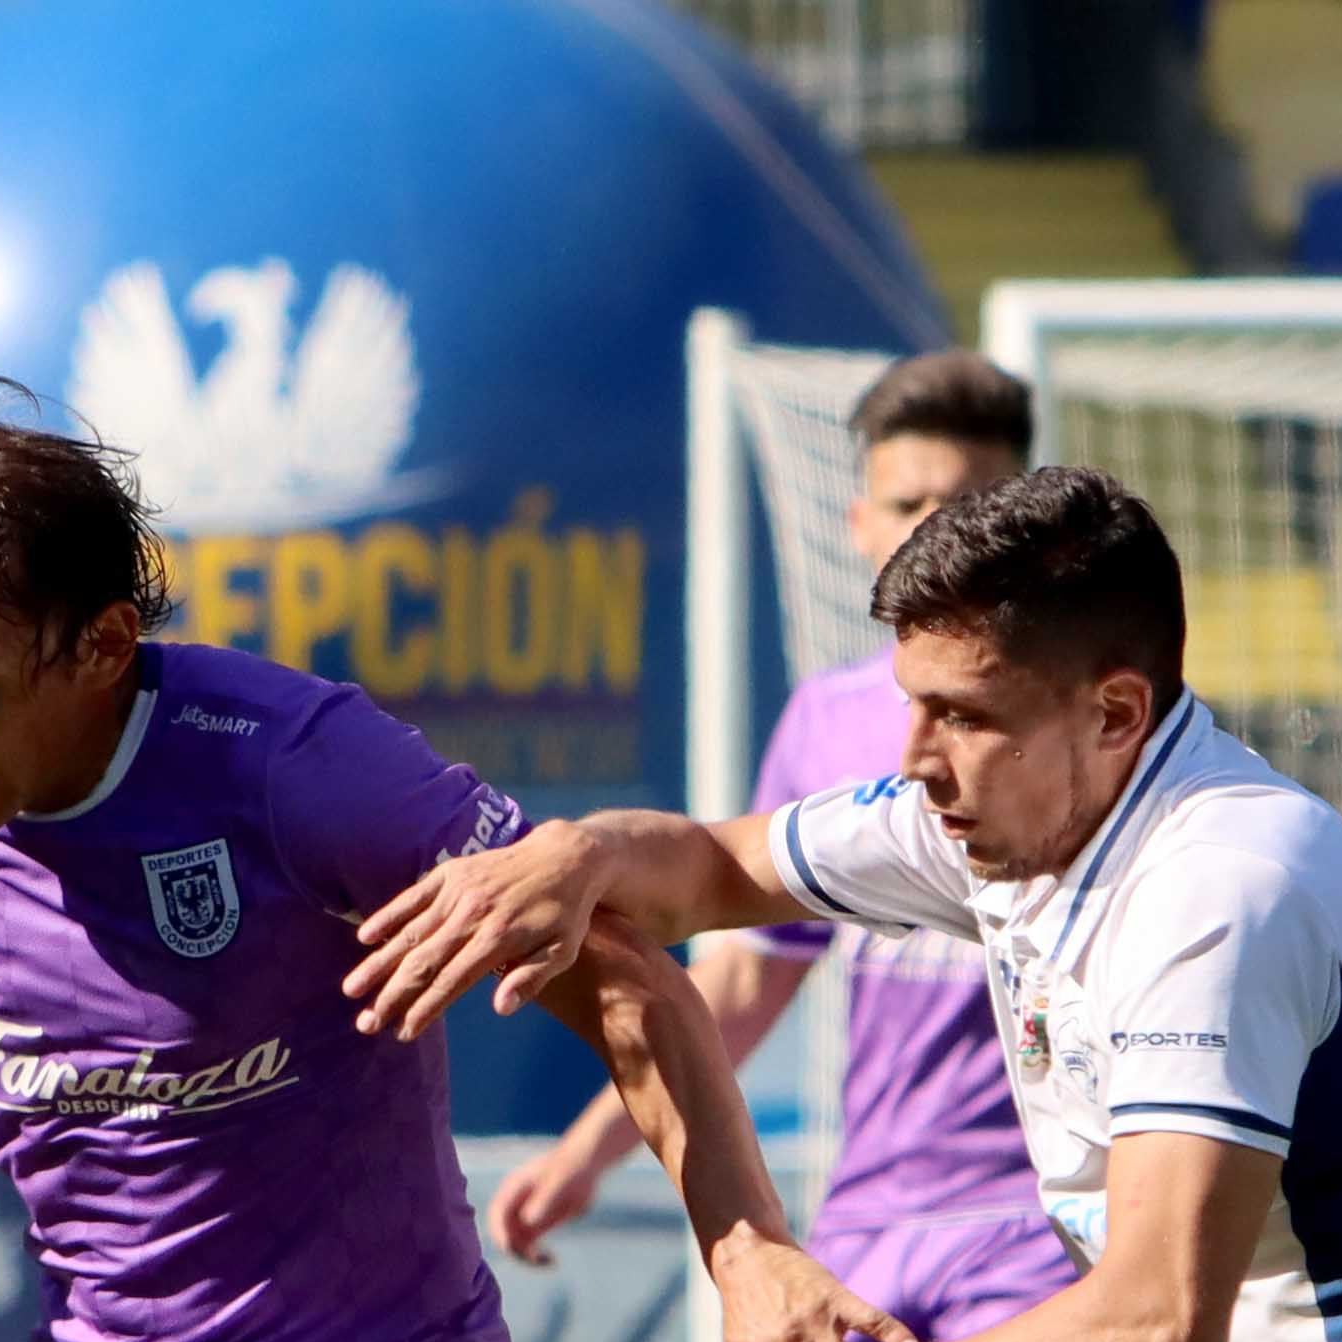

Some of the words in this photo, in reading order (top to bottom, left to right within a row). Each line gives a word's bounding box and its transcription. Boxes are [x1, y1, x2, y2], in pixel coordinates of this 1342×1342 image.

[148, 843, 222, 871] DEPORTES
[160, 907, 239, 954] CONCEPCION
[57, 1100, 120, 1114] DESDE
